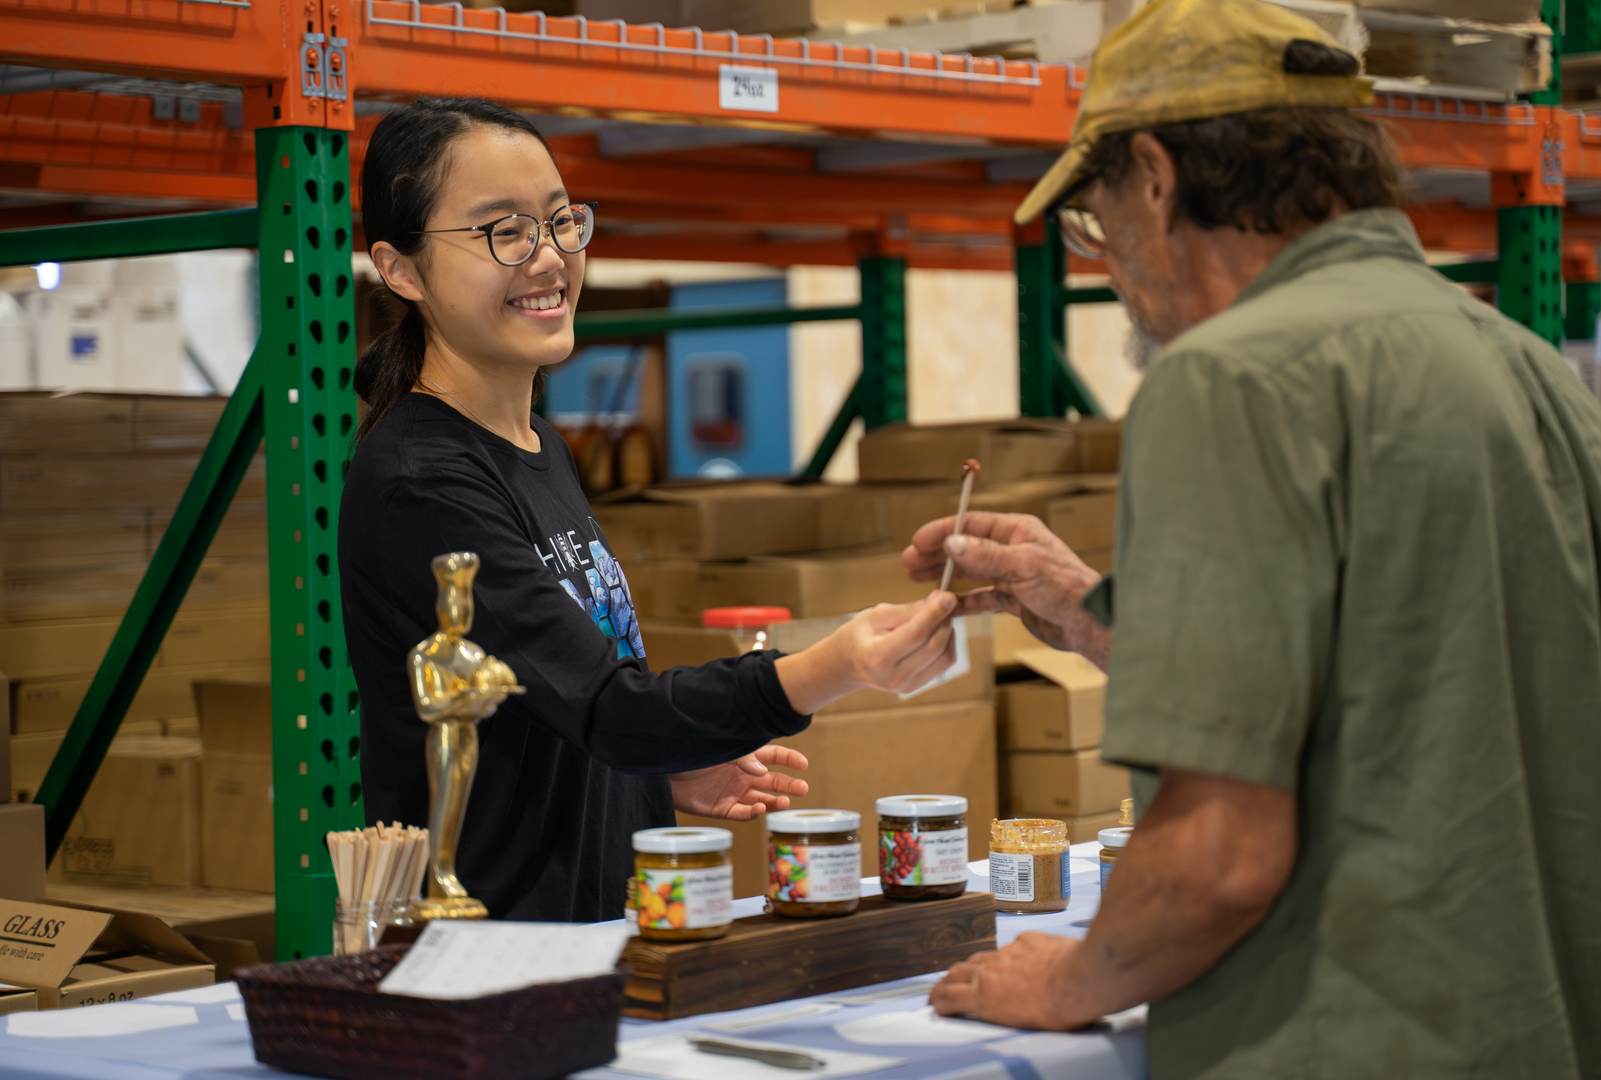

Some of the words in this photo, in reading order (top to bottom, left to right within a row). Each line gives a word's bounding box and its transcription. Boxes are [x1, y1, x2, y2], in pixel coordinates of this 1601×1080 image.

[3, 914, 66, 939] GLASS
[10, 946, 28, 959] with
[26, 951, 44, 961] care
